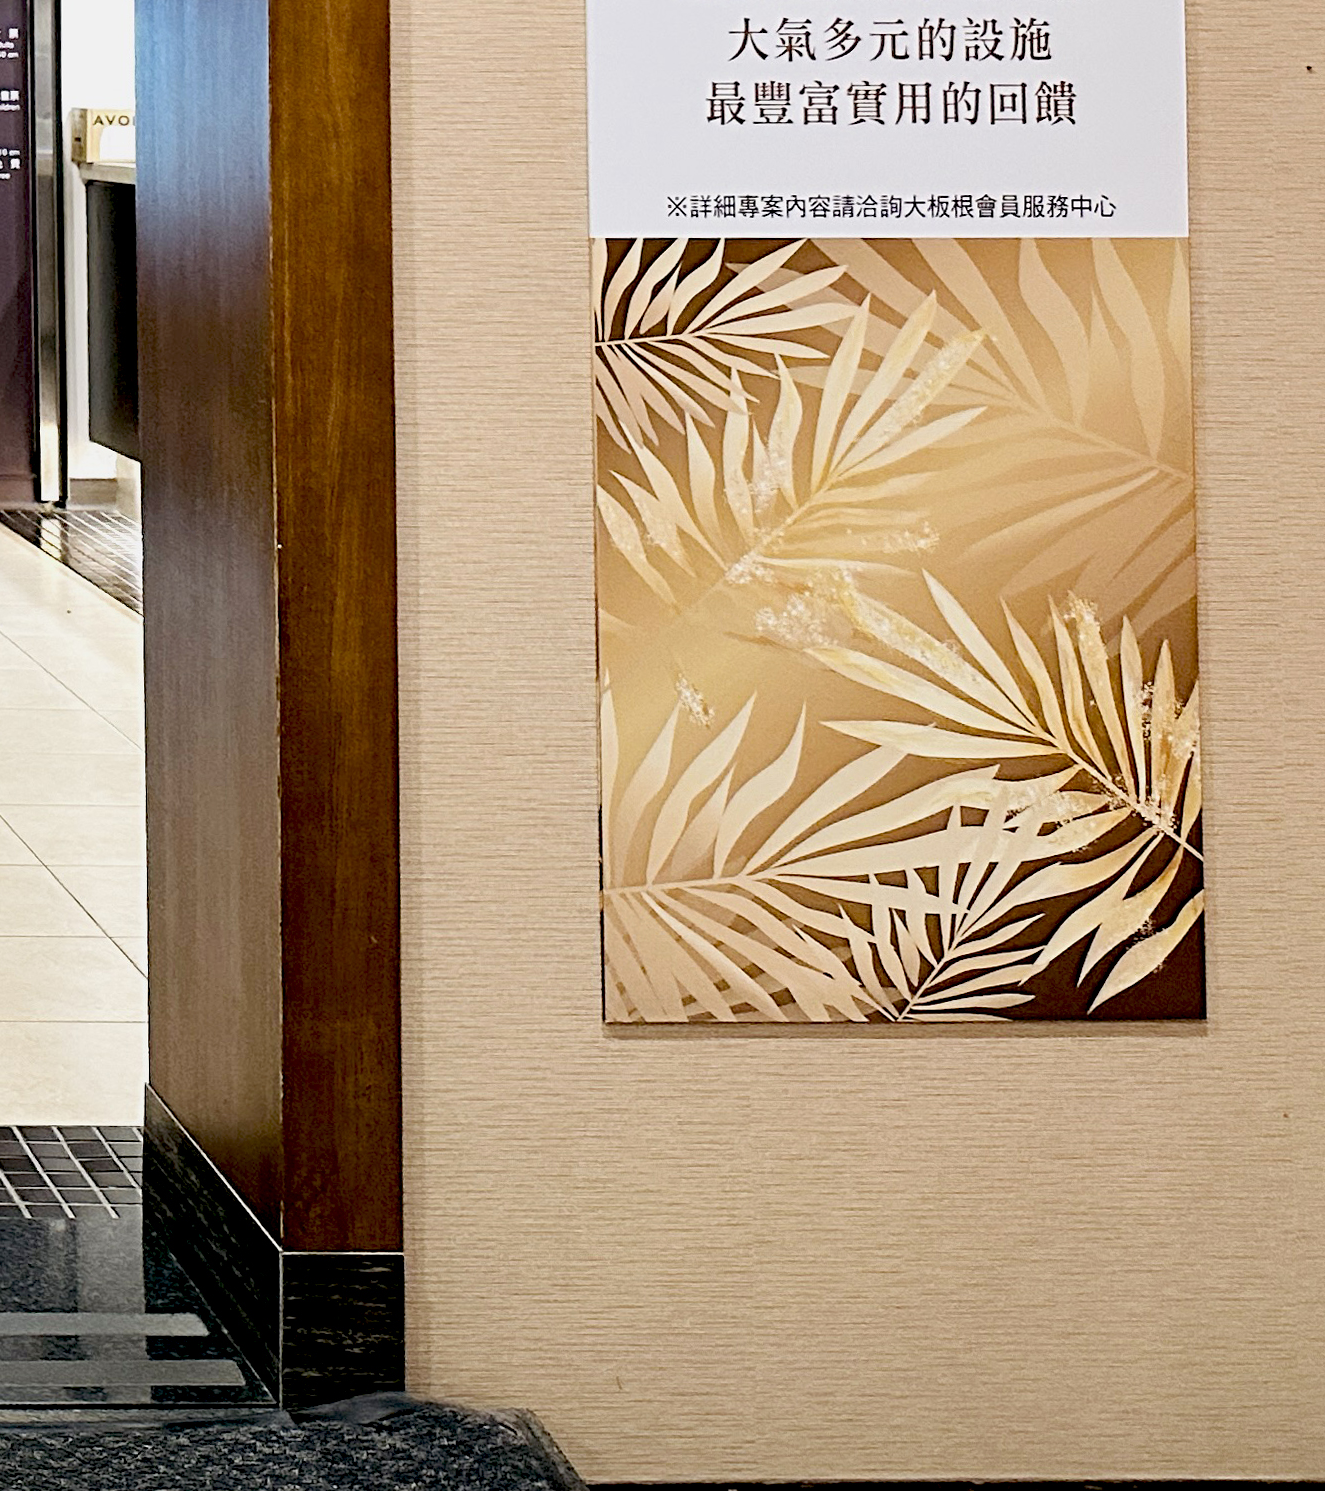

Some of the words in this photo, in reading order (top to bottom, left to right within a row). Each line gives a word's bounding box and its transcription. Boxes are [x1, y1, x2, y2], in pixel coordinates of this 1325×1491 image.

[729, 18, 1051, 62] 大氣多元的設施
[93, 115, 136, 126] AVO
[707, 81, 1076, 125] 最豐富實用的回饋
